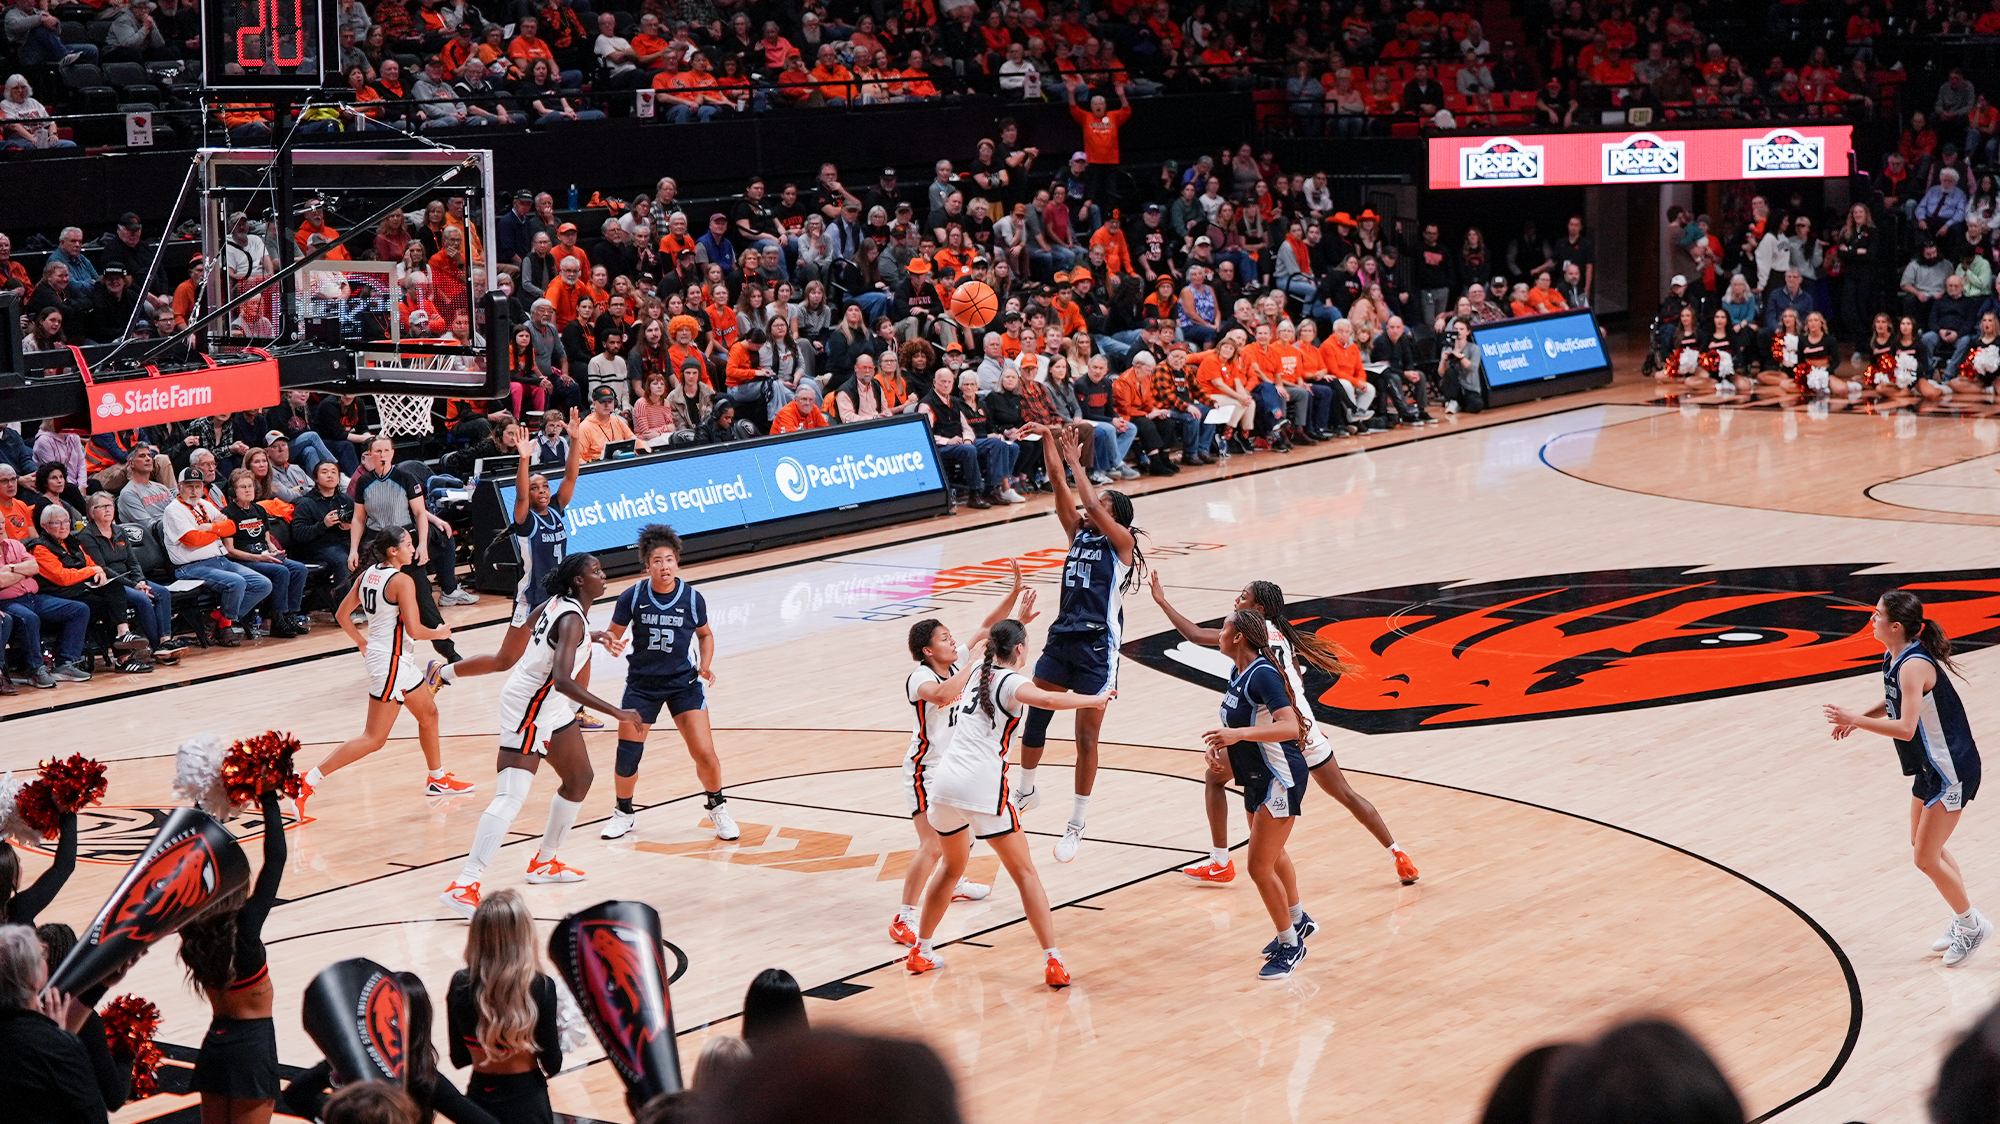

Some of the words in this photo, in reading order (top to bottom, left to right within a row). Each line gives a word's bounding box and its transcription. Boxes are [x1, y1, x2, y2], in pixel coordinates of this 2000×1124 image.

[236, 0, 303, 67] 20
[1482, 343, 1499, 357] Not
[1495, 340, 1512, 358] just
[1511, 336, 1534, 354] what's
[1554, 337, 1597, 354] PacificSource
[1497, 353, 1529, 373] required.
[806, 450, 925, 490] PacificSource
[566, 499, 606, 535] just
[606, 488, 669, 521] what's
[669, 474, 752, 513] required.
[541, 532, 555, 542] SAN
[553, 543, 563, 564] 4
[1080, 548, 1102, 560] DIEGO
[367, 573, 381, 585] YEPES
[1066, 561, 1092, 588] 24
[363, 586, 377, 614] 10
[641, 613, 659, 625] SAN
[660, 614, 684, 627] DIEGO
[647, 627, 674, 653] 22
[356, 971, 383, 1016] UNIVERSITY
[357, 1017, 371, 1045] STATE
[366, 1045, 395, 1079] OREGON
